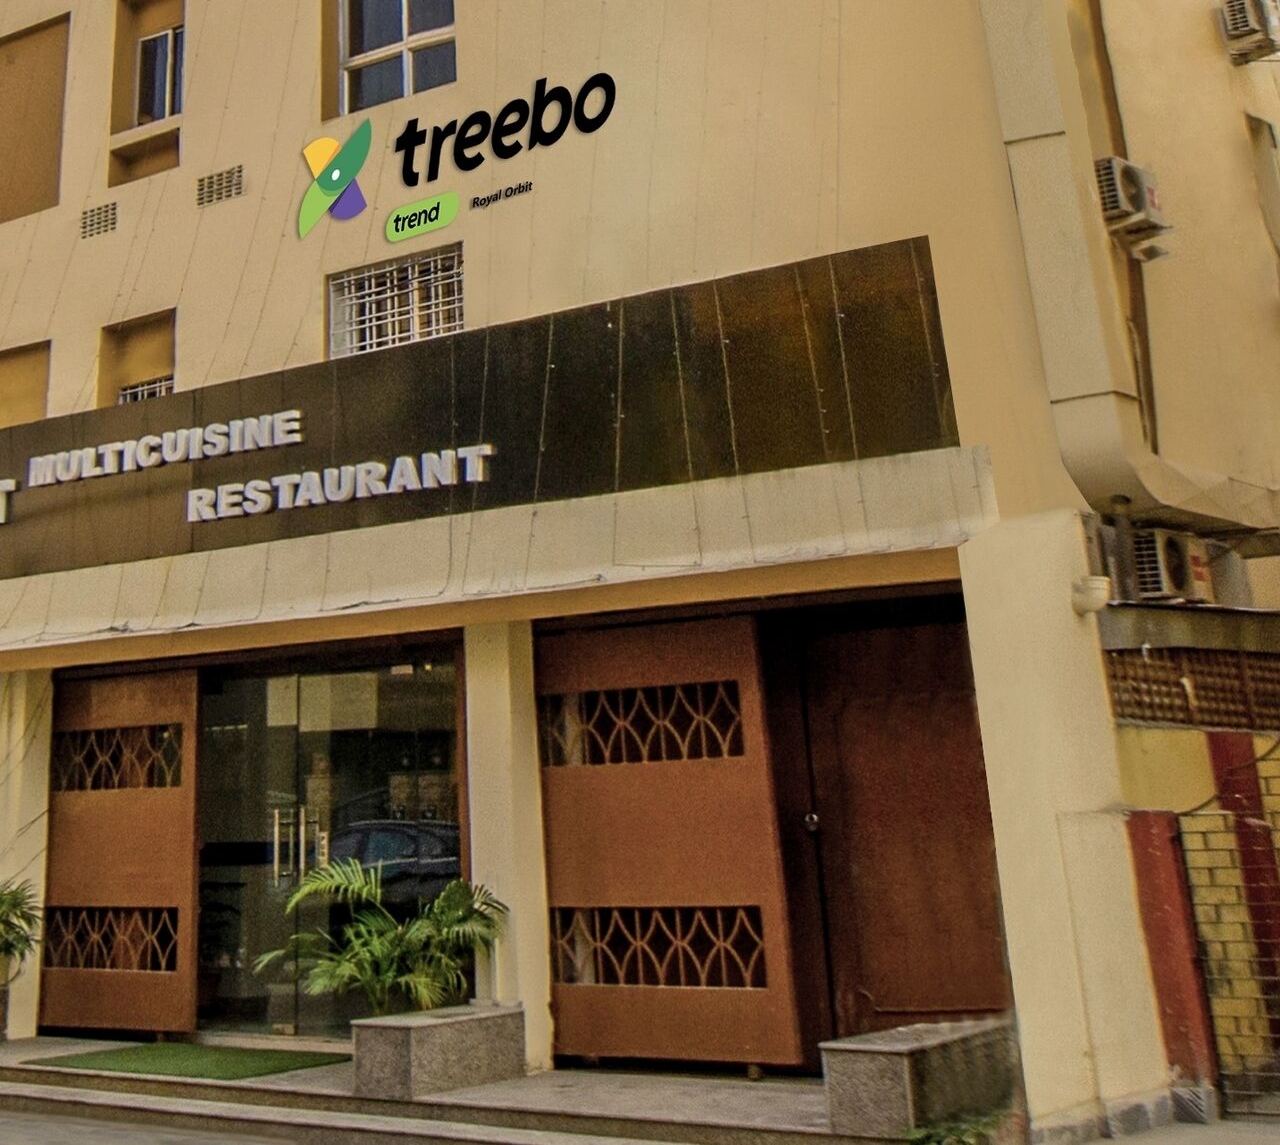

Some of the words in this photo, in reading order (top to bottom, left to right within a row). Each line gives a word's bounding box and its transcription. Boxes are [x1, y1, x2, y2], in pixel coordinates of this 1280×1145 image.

[394, 72, 616, 187] treebo
[393, 201, 441, 234] trend
[471, 189, 502, 209] Royal
[504, 180, 534, 198] Orbit
[27, 409, 304, 488] MULTICUISINE
[187, 443, 494, 523] RESTAURANT
